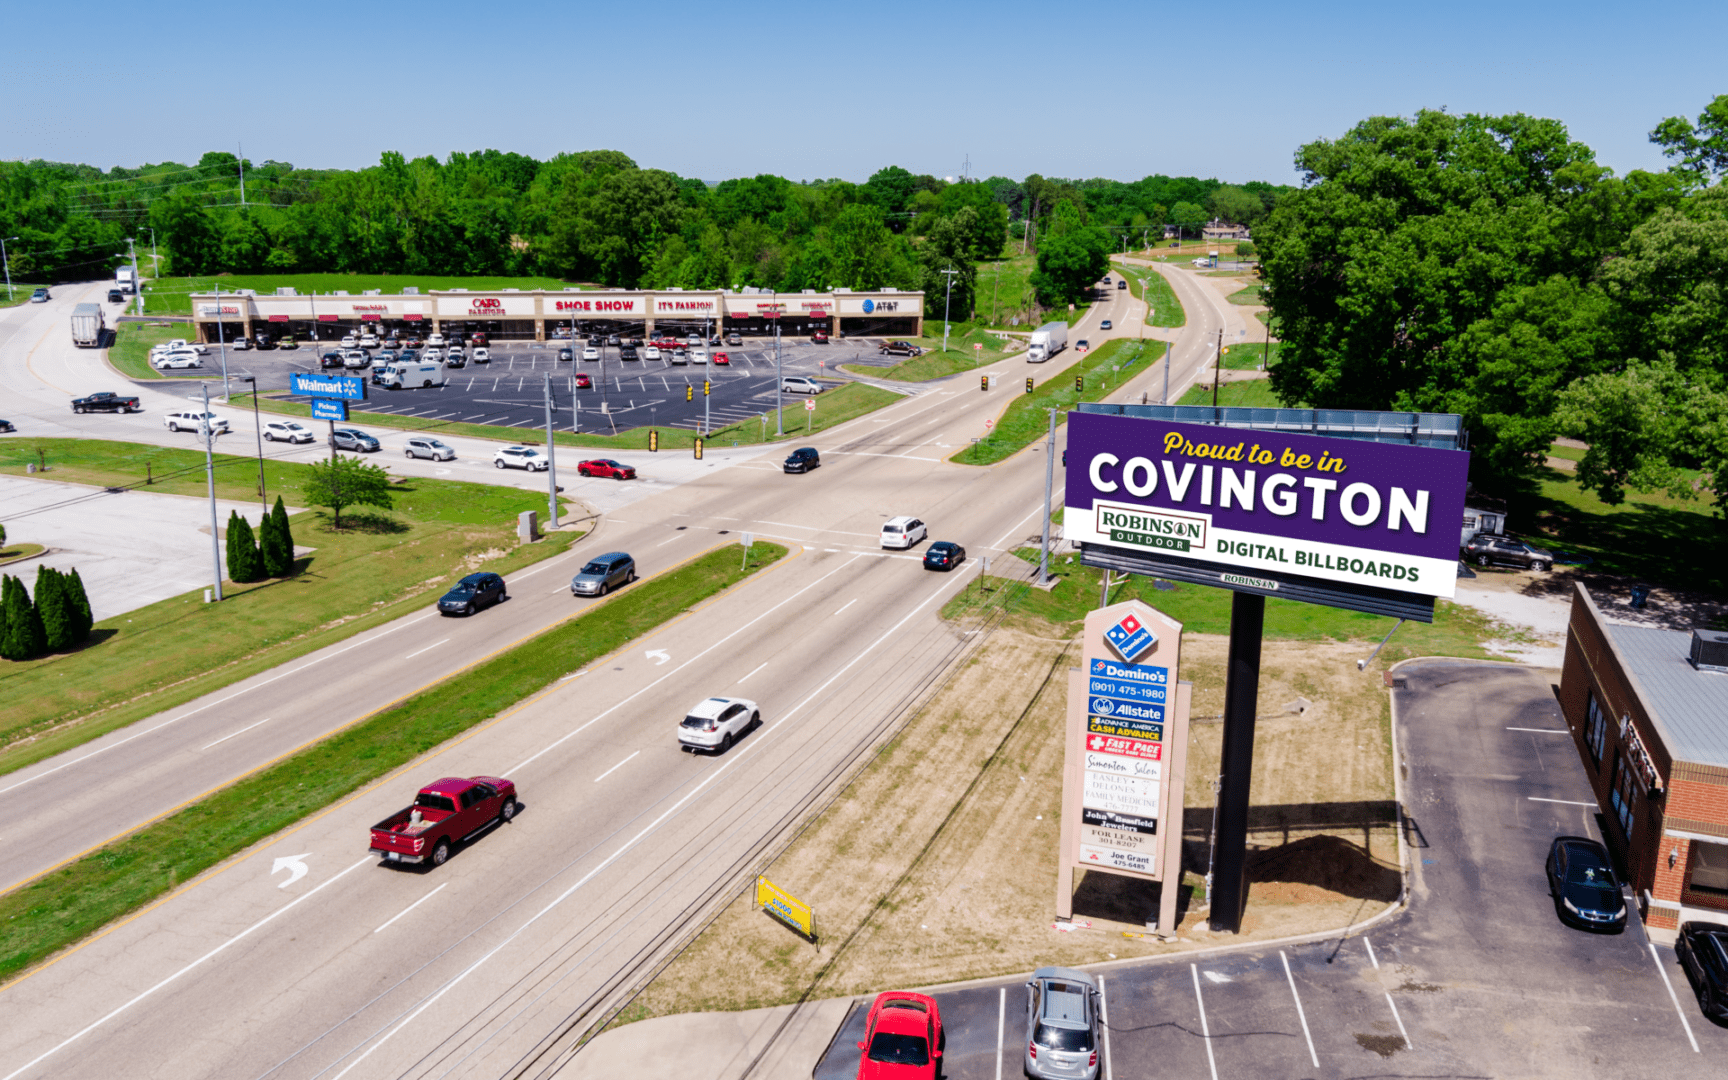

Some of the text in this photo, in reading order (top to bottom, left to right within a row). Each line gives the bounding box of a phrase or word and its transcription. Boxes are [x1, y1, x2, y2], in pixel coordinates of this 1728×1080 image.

[472, 298, 501, 308] CATO
[556, 301, 634, 311] SHOE SHOW
[658, 302, 673, 310] IT'S
[876, 301, 898, 311] AT&T
[297, 378, 343, 394] Walmart
[318, 402, 337, 412] Pickup
[314, 410, 342, 420] Pharmacy
[1163, 431, 1347, 473] Proud to be in
[1088, 452, 1431, 534] COVINGTON
[1102, 511, 1202, 539] ROBINSON
[1116, 531, 1185, 549] OUTDOOR
[1217, 539, 1420, 582] DIGITAL BILLBOARDS
[1224, 574, 1276, 590] ROBINSON
[1121, 631, 1149, 654] Domino's
[1106, 665, 1166, 683] Domino's
[1091, 681, 1165, 700] (901) 475-1980
[1115, 703, 1161, 720] Allstate
[1090, 724, 1160, 741] CASH ADVANCE
[1100, 719, 1160, 732] ADVANCE AMERICA
[1105, 738, 1161, 754] FAST PACE
[1087, 754, 1158, 775] Simonton Salon
[1093, 773, 1129, 784] EASLEY
[1092, 781, 1136, 794] DELONES
[1085, 790, 1157, 808] FAMILY MEDICINE
[1085, 811, 1107, 821] John
[1100, 820, 1138, 833] Jewelers
[1091, 829, 1145, 844] FOR LEASE
[1098, 837, 1137, 848] 301-8207
[1110, 851, 1125, 860] Joe
[1126, 854, 1150, 864] Grant
[1113, 859, 1146, 870] 475-6485
